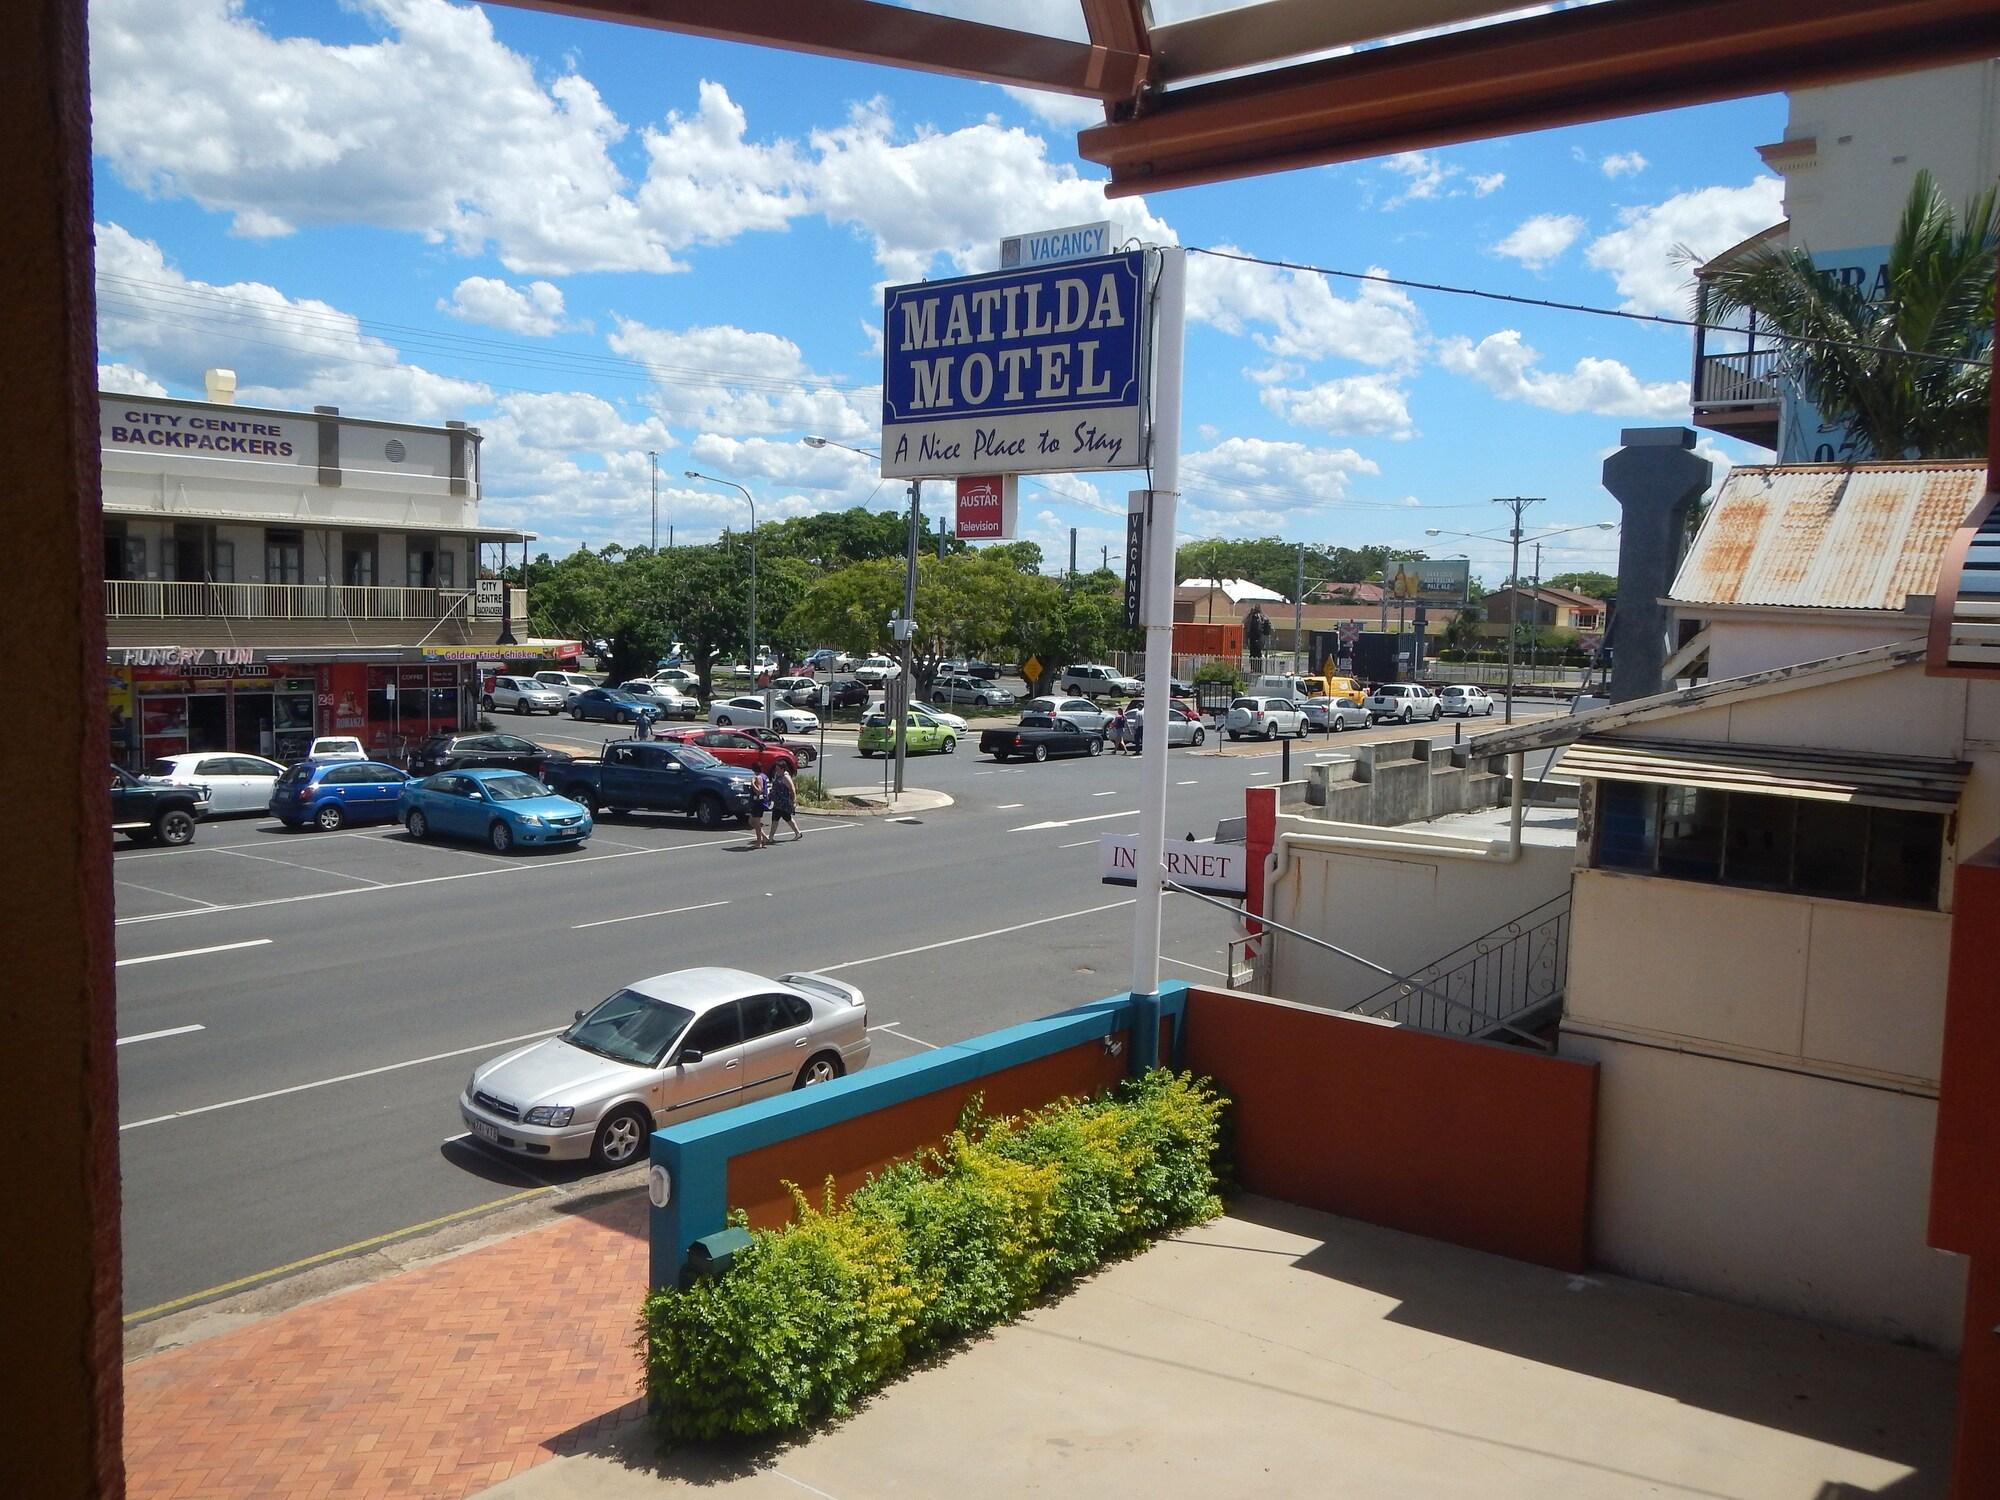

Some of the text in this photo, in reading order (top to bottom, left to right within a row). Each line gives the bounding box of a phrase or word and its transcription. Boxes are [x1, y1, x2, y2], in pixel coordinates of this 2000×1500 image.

[1030, 228, 1104, 260] VACANCY
[900, 273, 1125, 352] MATILDA
[909, 340, 1111, 409] MOTEL
[124, 411, 281, 437] CITY CENTRE
[111, 426, 293, 457] BACKPACKERS
[894, 421, 1123, 464] A Nice Place to Stay
[960, 494, 998, 507] AUSTAR
[959, 521, 999, 532] Television
[1128, 514, 1139, 625] VACANCY
[481, 581, 497, 591] CITY
[477, 593, 503, 604] CENTRE
[124, 647, 254, 666] HUNGRY TUM
[444, 651, 476, 660] Golden
[478, 650, 500, 659] Fried
[504, 650, 537, 659] Chicken
[178, 665, 269, 678] Hungry Tum
[318, 693, 335, 706] 24
[1113, 846, 1231, 878] INRNET
